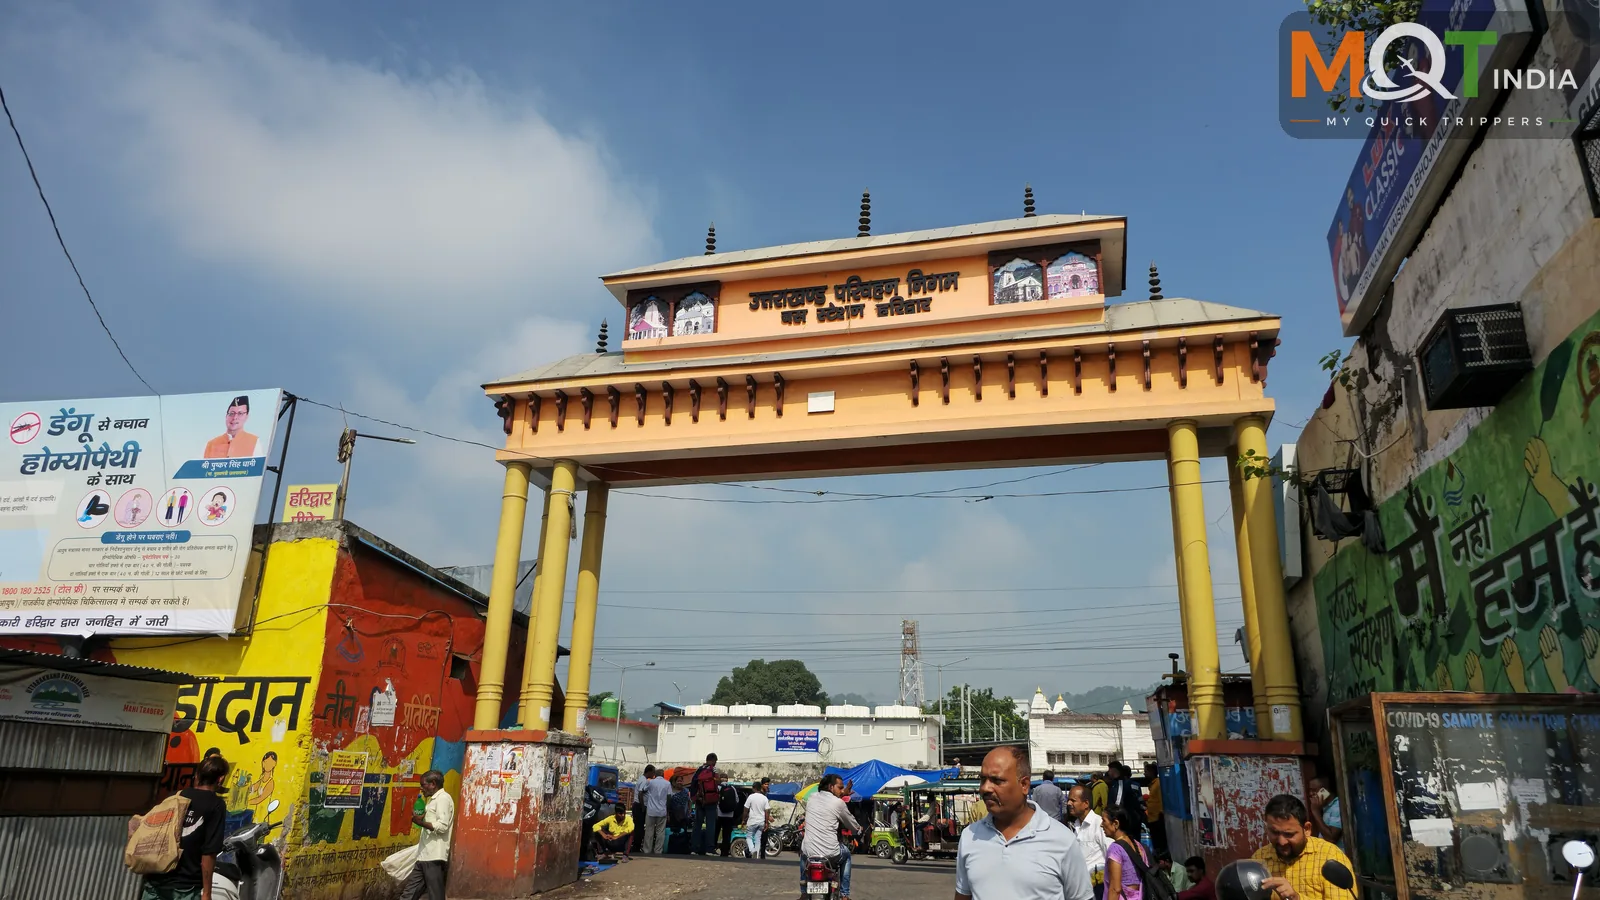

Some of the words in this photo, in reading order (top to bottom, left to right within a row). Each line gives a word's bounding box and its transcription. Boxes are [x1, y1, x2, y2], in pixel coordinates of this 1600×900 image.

[1364, 128, 1405, 221] CLASSIC
[1386, 183, 1415, 236] VAISHNO
[749, 285, 828, 310] उत्तराखण्ड
[834, 275, 900, 303] परिवहन
[907, 269, 960, 296] निगम
[781, 309, 808, 325] बस
[816, 302, 865, 322] स्टेशन
[877, 296, 933, 318] हरिद्वार
[47, 407, 94, 443] डेंगू
[98, 417, 110, 431] से
[113, 417, 150, 431] बचाव
[20, 440, 142, 475] होम्योपैथी
[201, 461, 209, 469] श्री
[211, 461, 228, 471] पुष्कर
[228, 460, 242, 469] सिंह
[242, 458, 256, 467] धामी
[86, 472, 102, 487] के
[105, 473, 136, 486] साथ
[289, 487, 333, 508] हरिद्वार
[116, 533, 125, 542] डेंगू
[126, 533, 136, 541] होने
[1389, 486, 1441, 617] मैं
[1448, 494, 1491, 563] नहीं
[20, 587, 32, 595] 180
[33, 586, 51, 594] 2525
[103, 583, 123, 593] सम्पर्क
[1469, 518, 1569, 639] हम
[23, 597, 45, 606] राजकीय
[128, 595, 149, 605] सम्पर्क
[163, 597, 180, 605] सकते
[25, 615, 56, 628] हरिद्वार
[60, 618, 80, 628] द्वारा
[85, 615, 124, 627] जनहित
[129, 615, 142, 627] में
[145, 614, 169, 627] जारी
[123, 703, 138, 713] MANI
[139, 705, 165, 716] TRADERS
[400, 694, 441, 735] प्रतिदिन
[1386, 711, 1440, 728] COVID-19
[1442, 713, 1494, 729] SAMPLE
